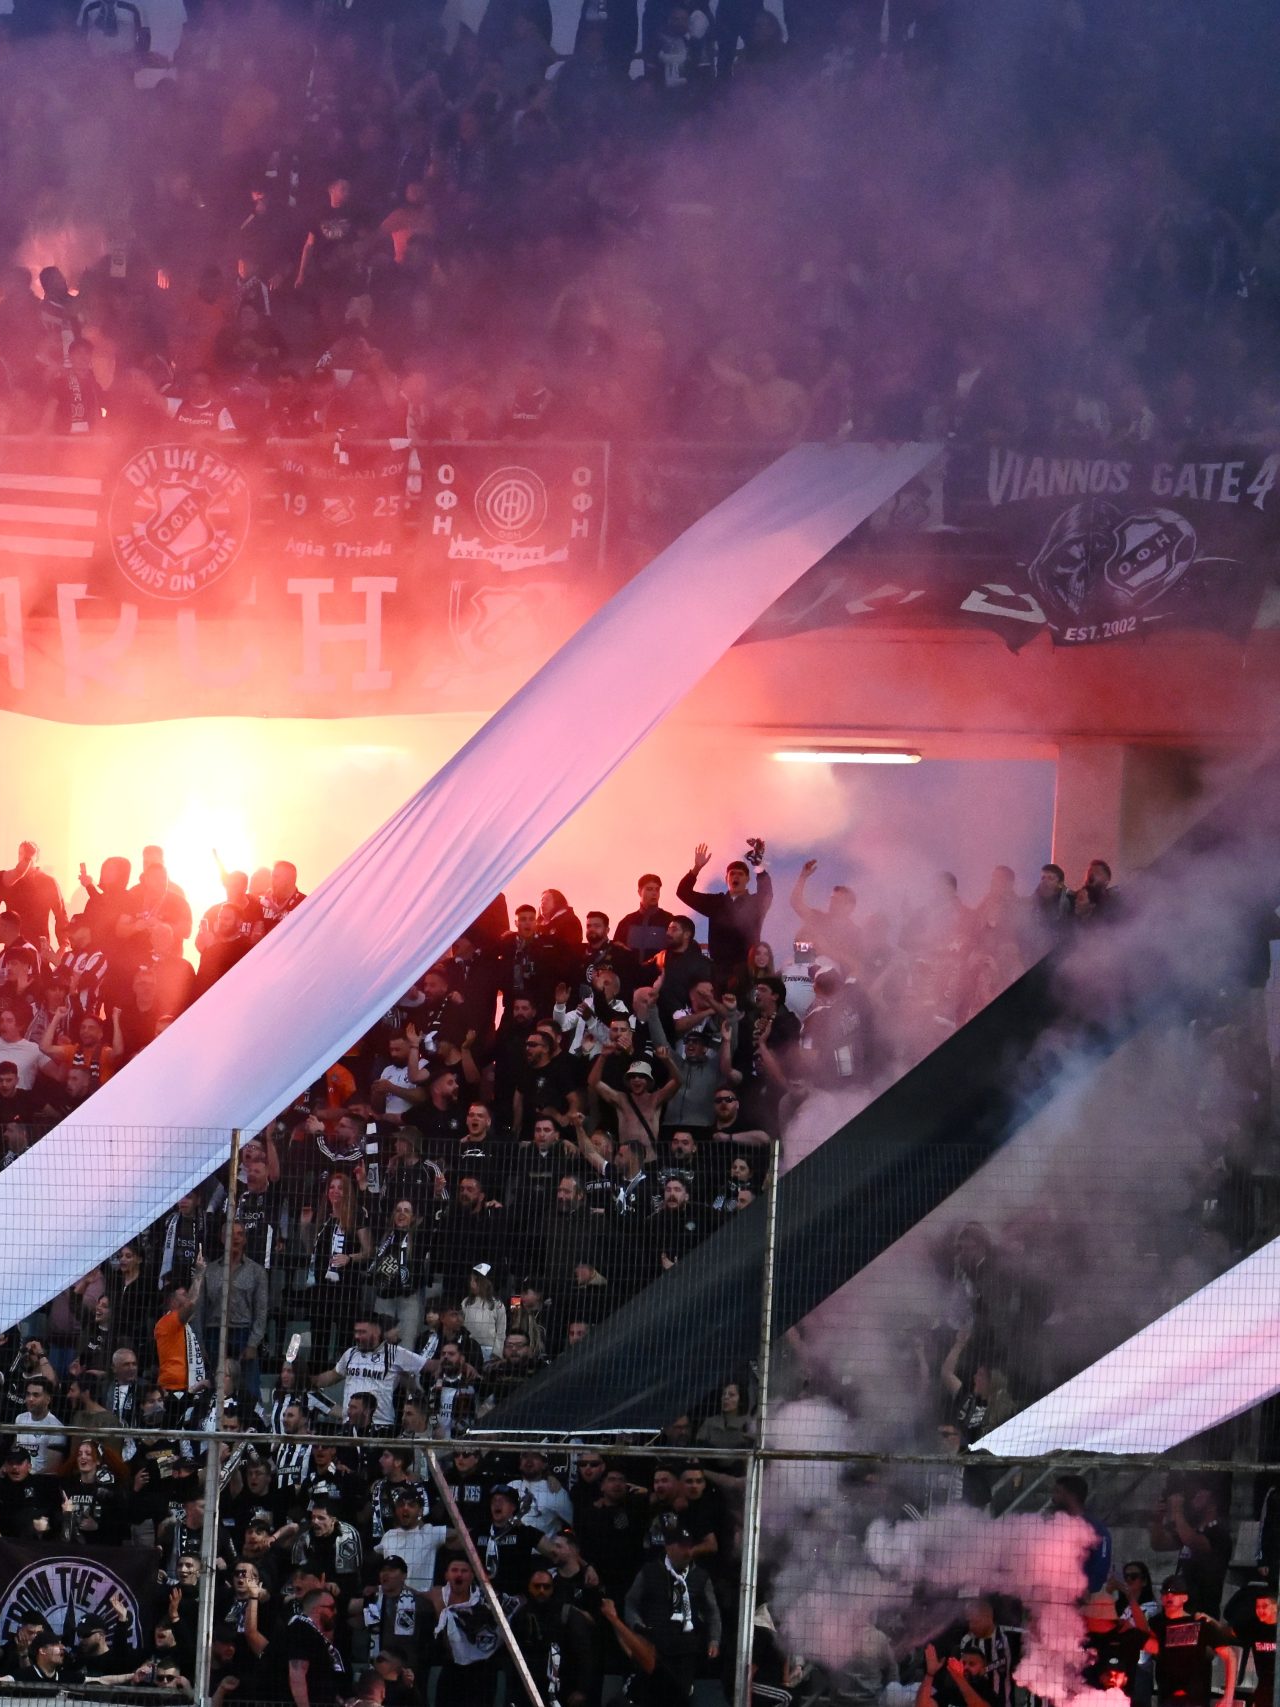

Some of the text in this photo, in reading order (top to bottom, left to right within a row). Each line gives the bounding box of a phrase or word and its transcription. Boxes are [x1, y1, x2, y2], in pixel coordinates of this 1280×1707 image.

[125, 451, 158, 487] OFI
[163, 449, 198, 472] UK
[987, 446, 1280, 511] VIANNOS GATE 4
[283, 492, 400, 517] 19 25
[116, 535, 238, 592] ALWAYS ON TOUR
[284, 536, 392, 558] Agia Triada
[1103, 616, 1137, 638] 2002
[55, 1567, 104, 1609] THE
